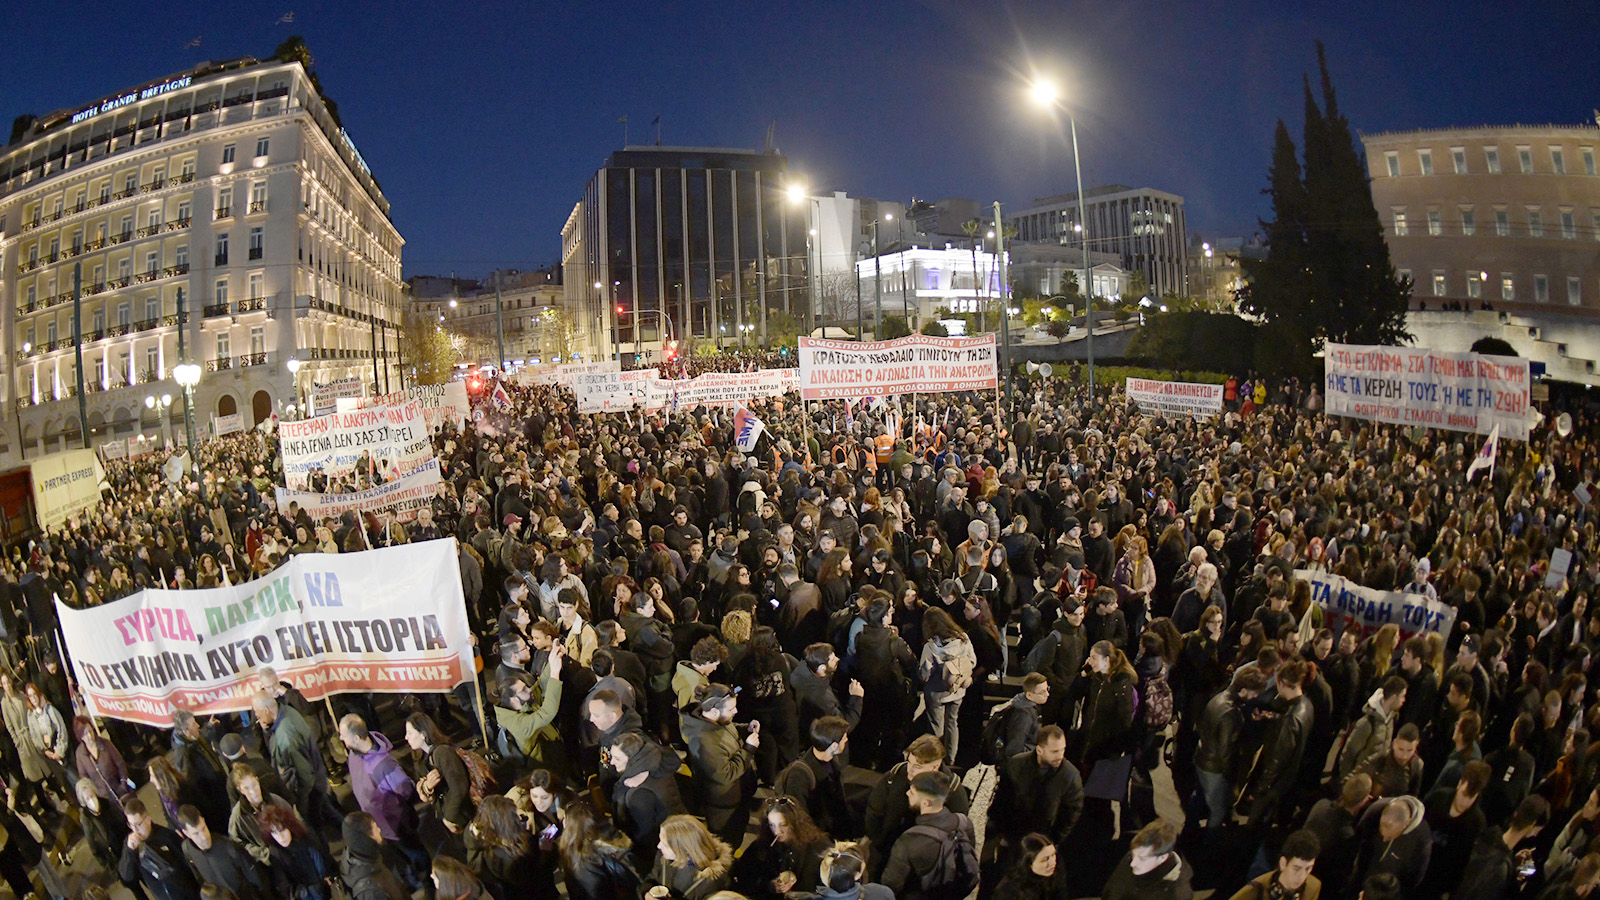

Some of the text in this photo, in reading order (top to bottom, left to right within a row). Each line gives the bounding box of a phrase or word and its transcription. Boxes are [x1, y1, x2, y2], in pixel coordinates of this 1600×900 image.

[72, 77, 192, 124] HOTEL GRANDE BRETAGNE
[807, 339, 886, 350] ΟΜΟΣΠΟΝΔΙΑ
[890, 336, 954, 348] ΟΙΚΟΔΟΜΩΝ
[867, 348, 914, 364] ΚΕΦΑΛΑΙΟ
[967, 349, 977, 362] ΤΗ
[979, 347, 992, 360] ΖΩΗ
[810, 367, 863, 385] ΔΙΚΑΙΩΣΗ
[865, 367, 873, 382] Ο
[876, 366, 910, 382] ΑΓΩΝΑΣ
[911, 365, 926, 379] ΓΙΑ
[928, 365, 948, 379] ΤΗΝ
[1337, 351, 1352, 369] ΤΟ
[1355, 352, 1403, 373] ΕΓΚΛΗΜΑ
[1408, 355, 1425, 374] ΣΤΑ
[1429, 355, 1455, 376] ΤΕΜΠΗ
[1457, 359, 1475, 378] ΜΑΣ
[409, 387, 414, 400] Ο
[416, 383, 446, 399] ΘΥΜΟΣ
[819, 380, 988, 397] ΣΥΝΔΙΚΑΤΟ ΟΙΚΟΔΟΜΩΝ ΑΘΗΝΑΣ
[1174, 384, 1212, 398] ΑΝΑΠΝΕΥΣΩ
[1335, 375, 1348, 394] ΜΕ
[1350, 376, 1362, 396] ΤΑ
[1364, 378, 1402, 399] ΚΕΡΔΗ
[1408, 381, 1438, 402] ΤΟΥΣ
[1457, 388, 1473, 407] ΜΕ
[1477, 389, 1492, 408] ΤΗ
[1496, 389, 1528, 416] ΖΩΗ!
[281, 416, 328, 438] ΣΤΕΡΕΨΑΝ
[330, 414, 341, 429] ΤΑ
[343, 410, 379, 429] ΔΑΚΡΥΑ
[1354, 403, 1478, 429] ΦΟΙΤΗΤΙΚΟΙ ΣΥΛΛΟΓΟΙ ΑΘΗΝΑΣ
[335, 432, 352, 449] ΔΕΝ
[354, 429, 376, 446] ΣΑΣ
[44, 467, 94, 491] PARTNER EXPRESS
[365, 496, 385, 509] ΣΤΗΝ
[386, 487, 423, 503] ΠΟΛΙΤΙΚΗ
[113, 572, 344, 647] ΣΥΡΙΖΑ, ΠΑΣΟΚ, ΝΔ
[1311, 580, 1331, 604] ΤΑ
[1338, 587, 1393, 623] ΚΕΡΔΗ
[1402, 604, 1445, 632] ΤΟΥΣ
[78, 614, 448, 690] ΤΟ ΕΓΚΛΗΜΑ ΑΥΤΟ ΕΧΕΙ ΙΣΤΟΡΙΑ
[99, 698, 178, 716] ΟΜΟΣΠΟΝΔΙΑ
[184, 680, 264, 706] ΣΥΝΔΙΚΑΤ
[377, 664, 452, 682] ΑΤΤΙΚΗΣ
